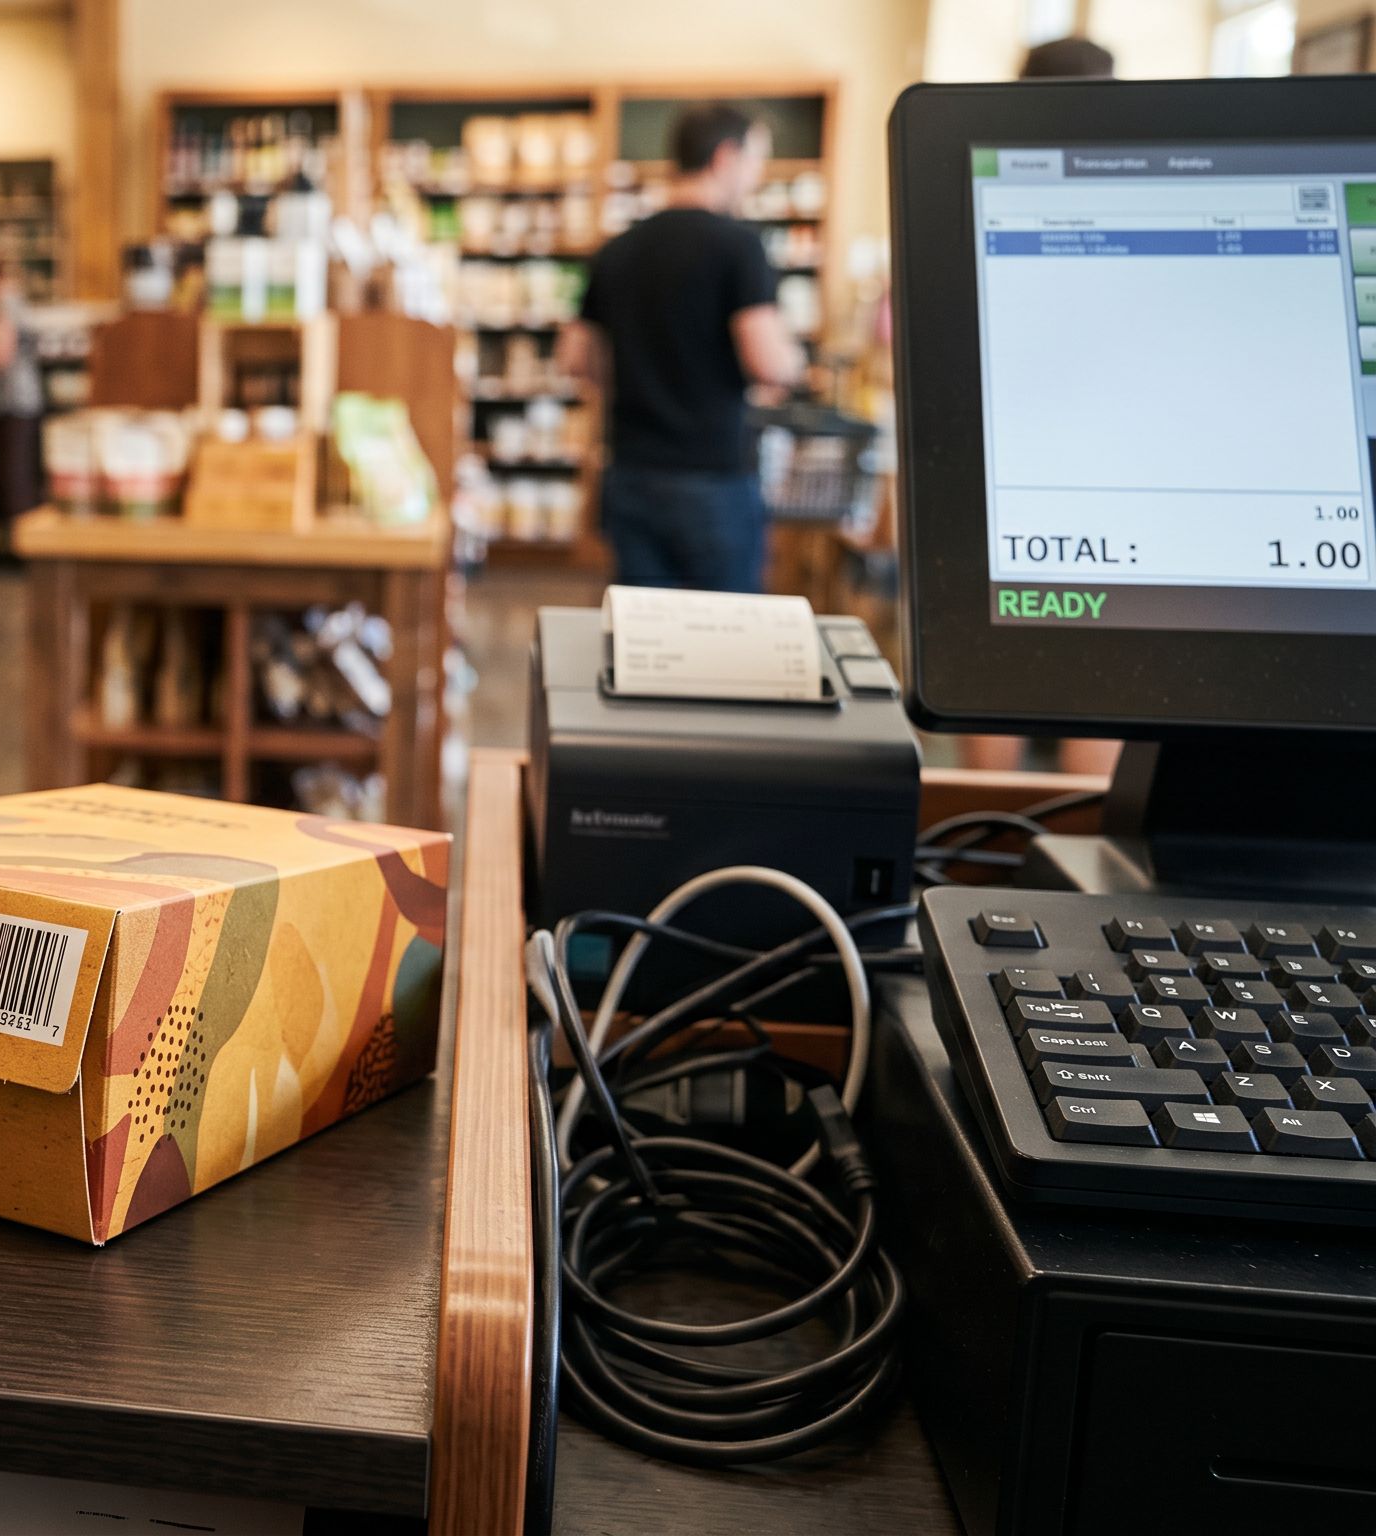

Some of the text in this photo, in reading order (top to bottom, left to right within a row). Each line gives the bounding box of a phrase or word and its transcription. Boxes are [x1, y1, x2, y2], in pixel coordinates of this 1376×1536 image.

[1314, 505, 1359, 521] 1.00
[1002, 534, 1362, 570] TOTAL: 1.00
[998, 589, 1107, 619] READY
[1027, 1003, 1050, 1012] Tab
[1141, 1007, 1162, 1019] Q
[1214, 1010, 1237, 1021] W
[1290, 1014, 1309, 1025] E
[52, 1025, 60, 1037] 7
[1039, 1036, 1109, 1047] Caps Lock
[1178, 1041, 1197, 1052] A
[1254, 1044, 1272, 1055] S
[1331, 1047, 1352, 1058] D
[1234, 1075, 1254, 1087] Z
[1315, 1079, 1337, 1091] X
[1069, 1105, 1097, 1114] Ctrl
